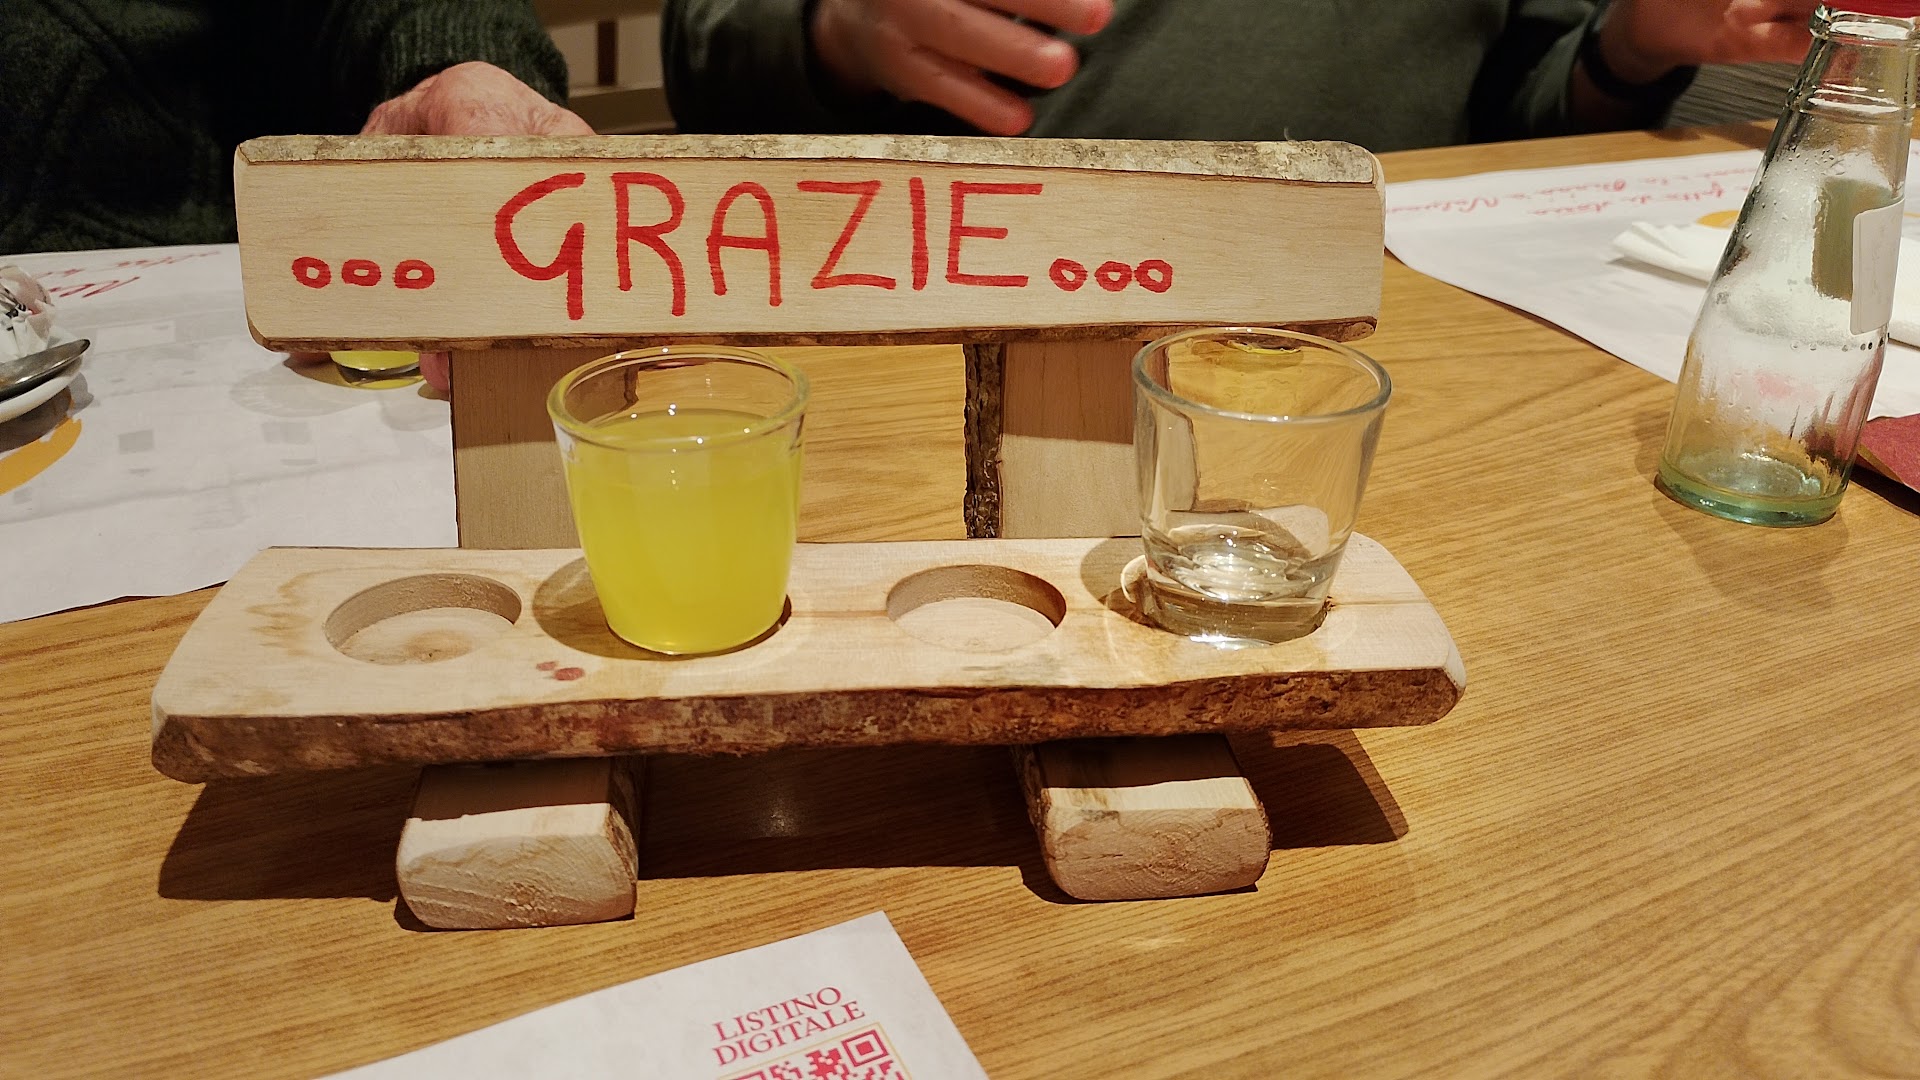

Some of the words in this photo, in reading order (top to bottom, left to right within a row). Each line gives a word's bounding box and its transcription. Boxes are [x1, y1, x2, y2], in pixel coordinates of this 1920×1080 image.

[494, 171, 1044, 320] GRAZIE
[713, 986, 842, 1042] LISTINO
[713, 1000, 866, 1066] DIGITALE
